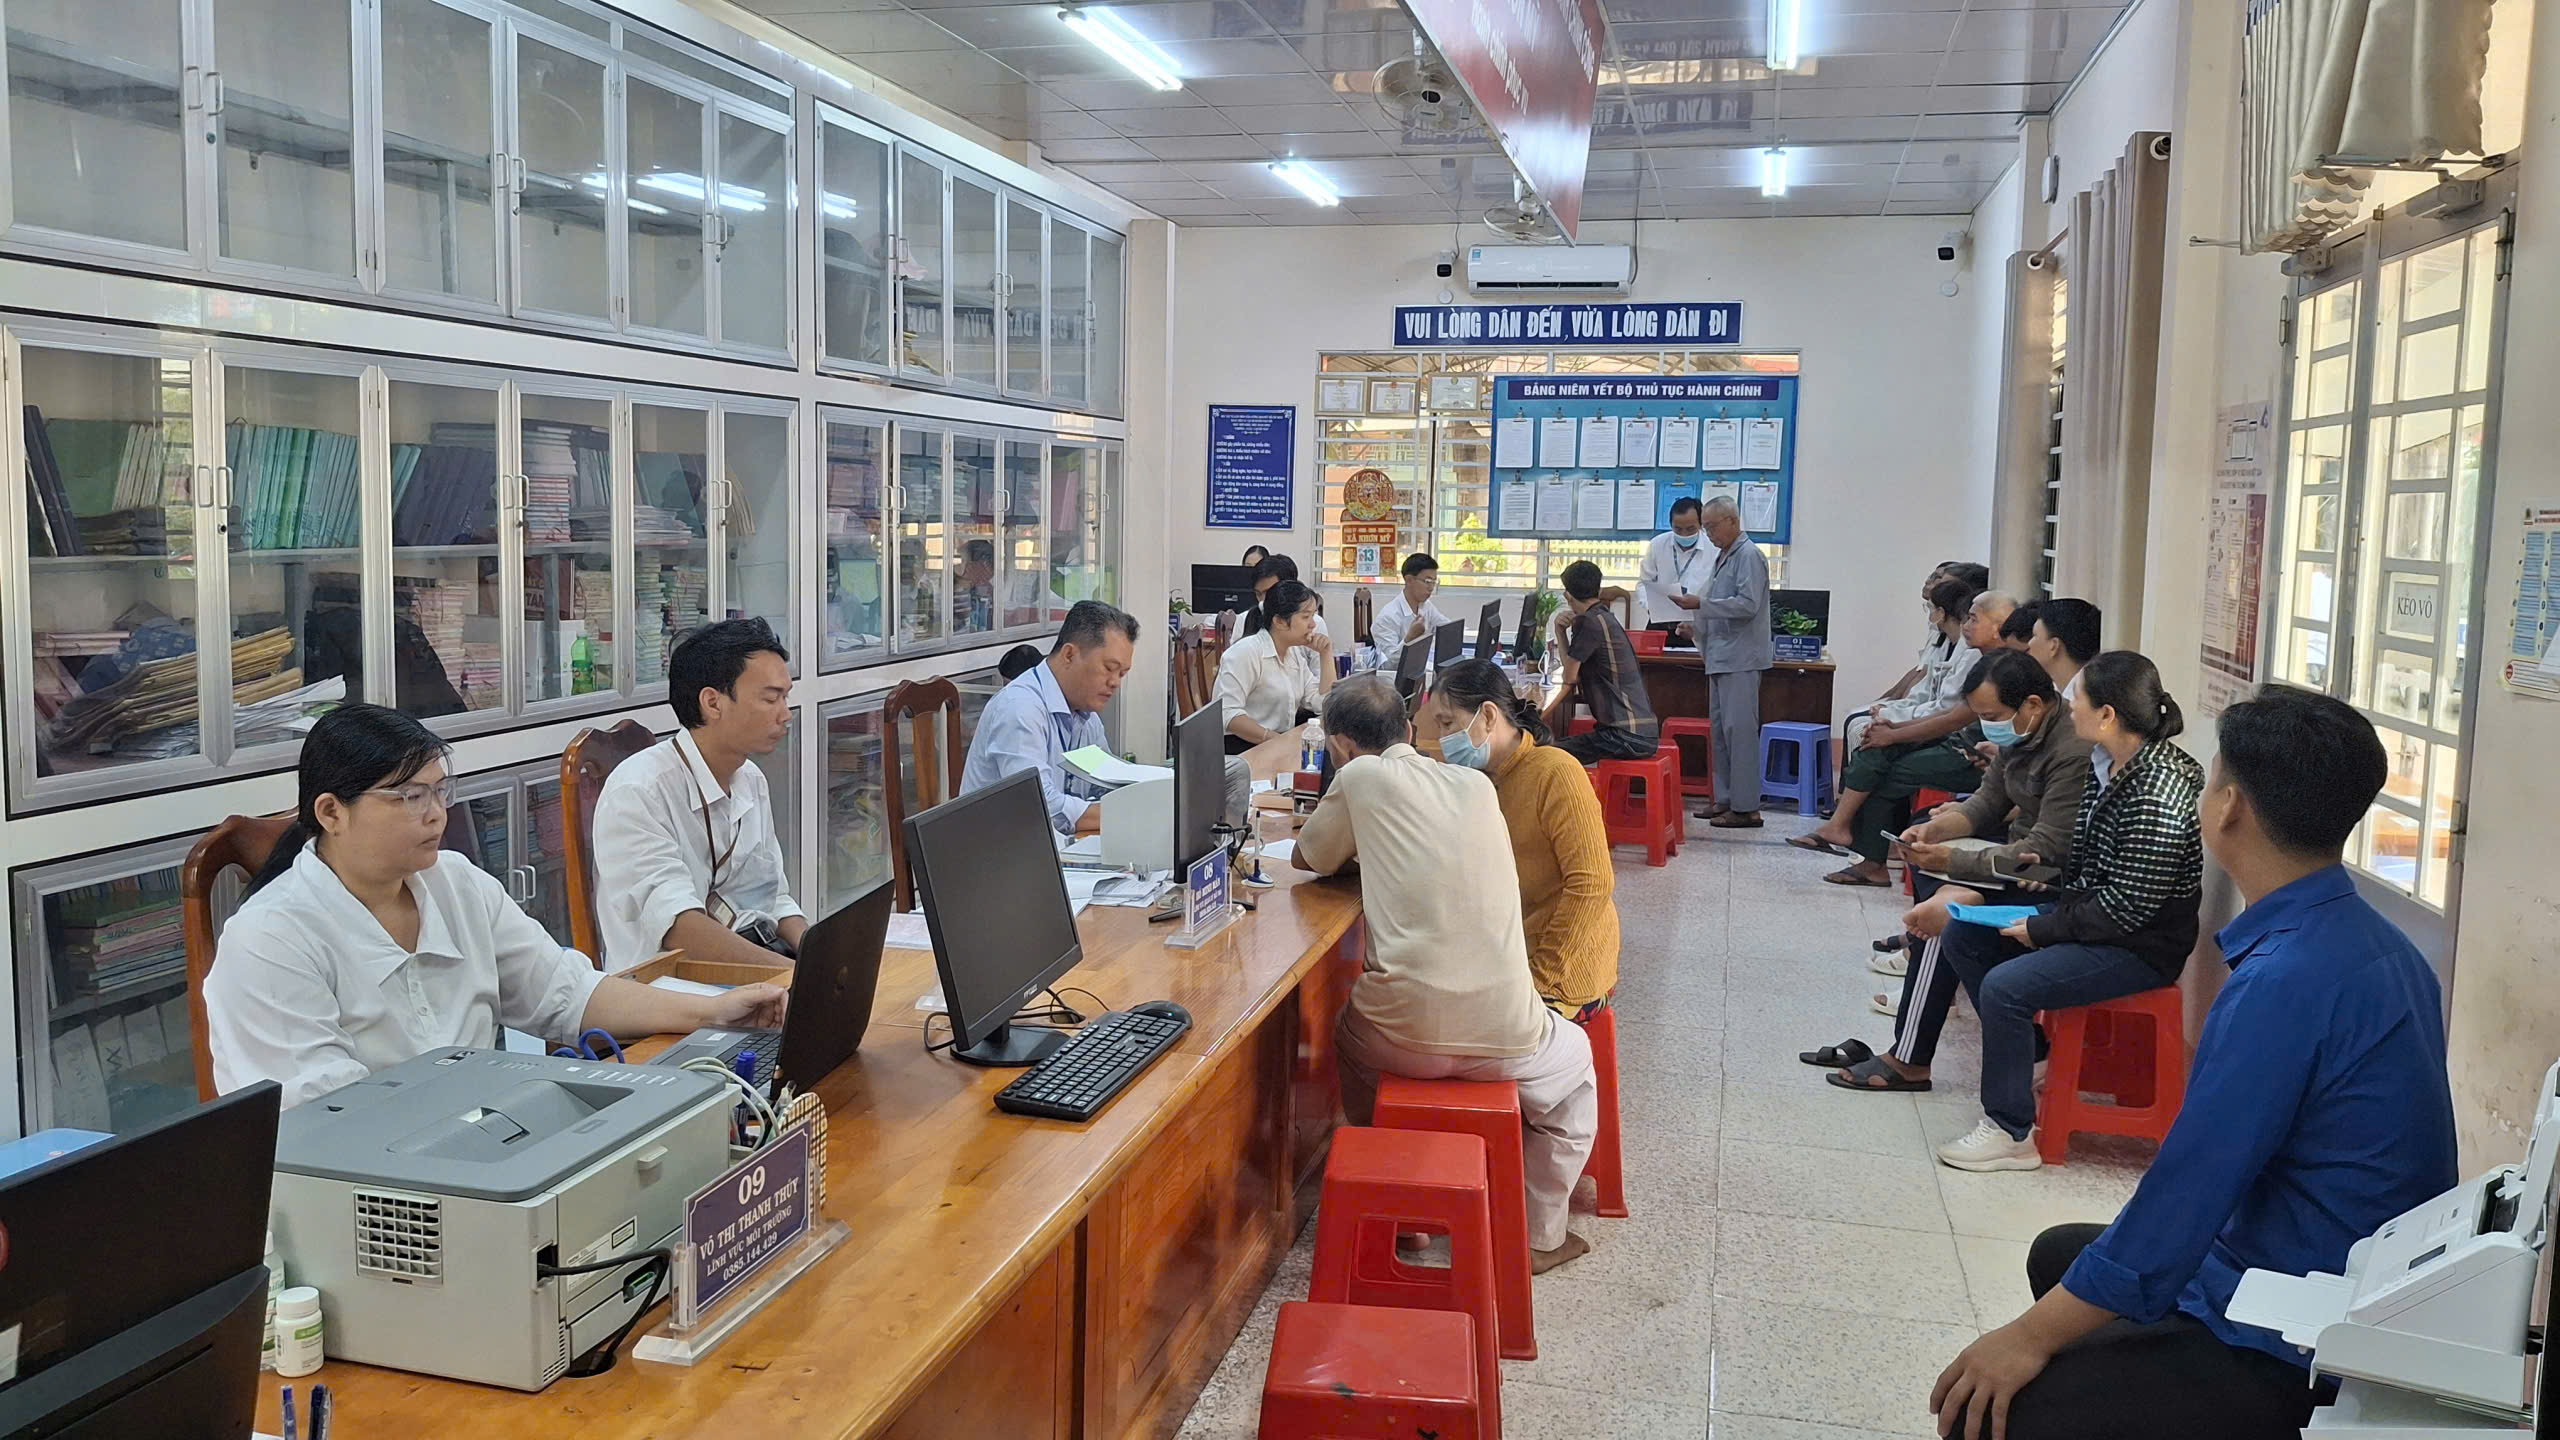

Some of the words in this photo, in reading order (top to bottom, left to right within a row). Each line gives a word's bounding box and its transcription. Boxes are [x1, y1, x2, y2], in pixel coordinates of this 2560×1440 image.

[1405, 312, 1431, 338] VUI
[1438, 307, 1481, 338] LÒNG
[1488, 309, 1521, 338] DÂN
[1571, 305, 1603, 337] VỪA
[1611, 305, 1657, 337] LÒNG
[1665, 307, 1700, 337] DÂN
[1709, 309, 1728, 337] ĐI
[1524, 382, 1555, 396] BẢNG
[1558, 383, 1589, 396] NIÊM
[1592, 381, 1613, 396] YẾT
[1616, 382, 1632, 398] BỘ
[1635, 382, 1658, 396] THỦ
[1661, 384, 1684, 398] TỤC
[1687, 383, 1720, 396] HÀNH
[1724, 383, 1762, 396] CHÍNH
[1363, 548, 1374, 561] 13
[1204, 862, 1213, 880] 08
[738, 1165, 765, 1205] 09
[717, 1223, 735, 1250] THỊ
[738, 1196, 771, 1233] THANH
[723, 1231, 778, 1281] 0385.144.429
[728, 1240, 744, 1260] VỰC
